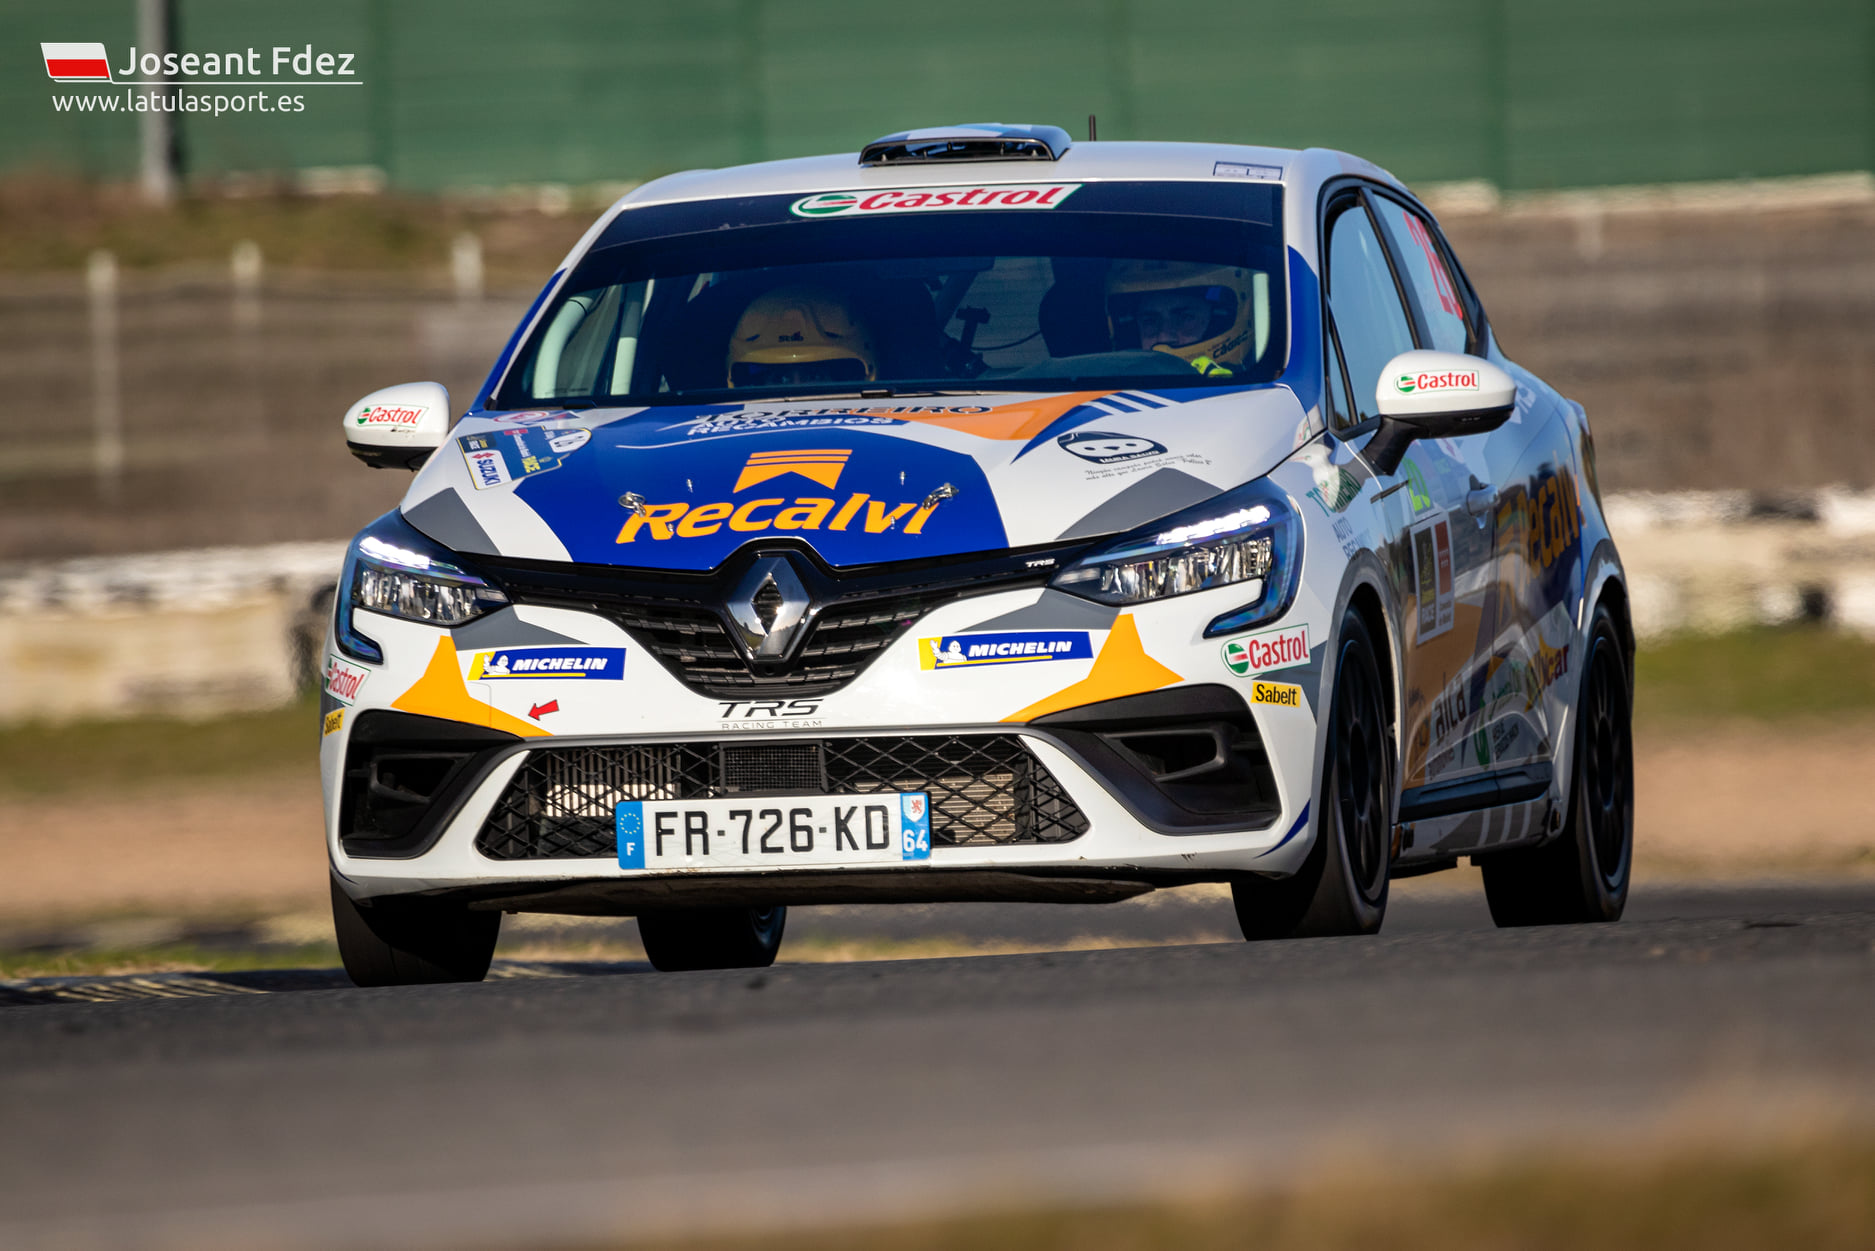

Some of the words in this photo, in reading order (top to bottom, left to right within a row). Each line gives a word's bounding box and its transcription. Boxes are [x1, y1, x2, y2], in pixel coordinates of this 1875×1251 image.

[859, 187, 1065, 210] Castrol
[1417, 372, 1478, 390] Castrol
[368, 407, 422, 424] Castrol
[687, 416, 893, 436] RECAMBIOS
[477, 459, 502, 486] SUZUKI
[616, 492, 939, 544] Recalvi
[1025, 558, 1055, 568] TRS
[968, 641, 1072, 658] MICHELIN
[1249, 629, 1309, 669] Castrol
[512, 657, 608, 671] MICHELIN
[1255, 683, 1297, 706] Sabelt
[719, 698, 824, 718] TRS
[721, 721, 775, 731] RACING
[782, 720, 823, 729] TEAM
[655, 804, 890, 857] FR-726-KD
[903, 829, 928, 852] 64
[626, 842, 635, 857] F
